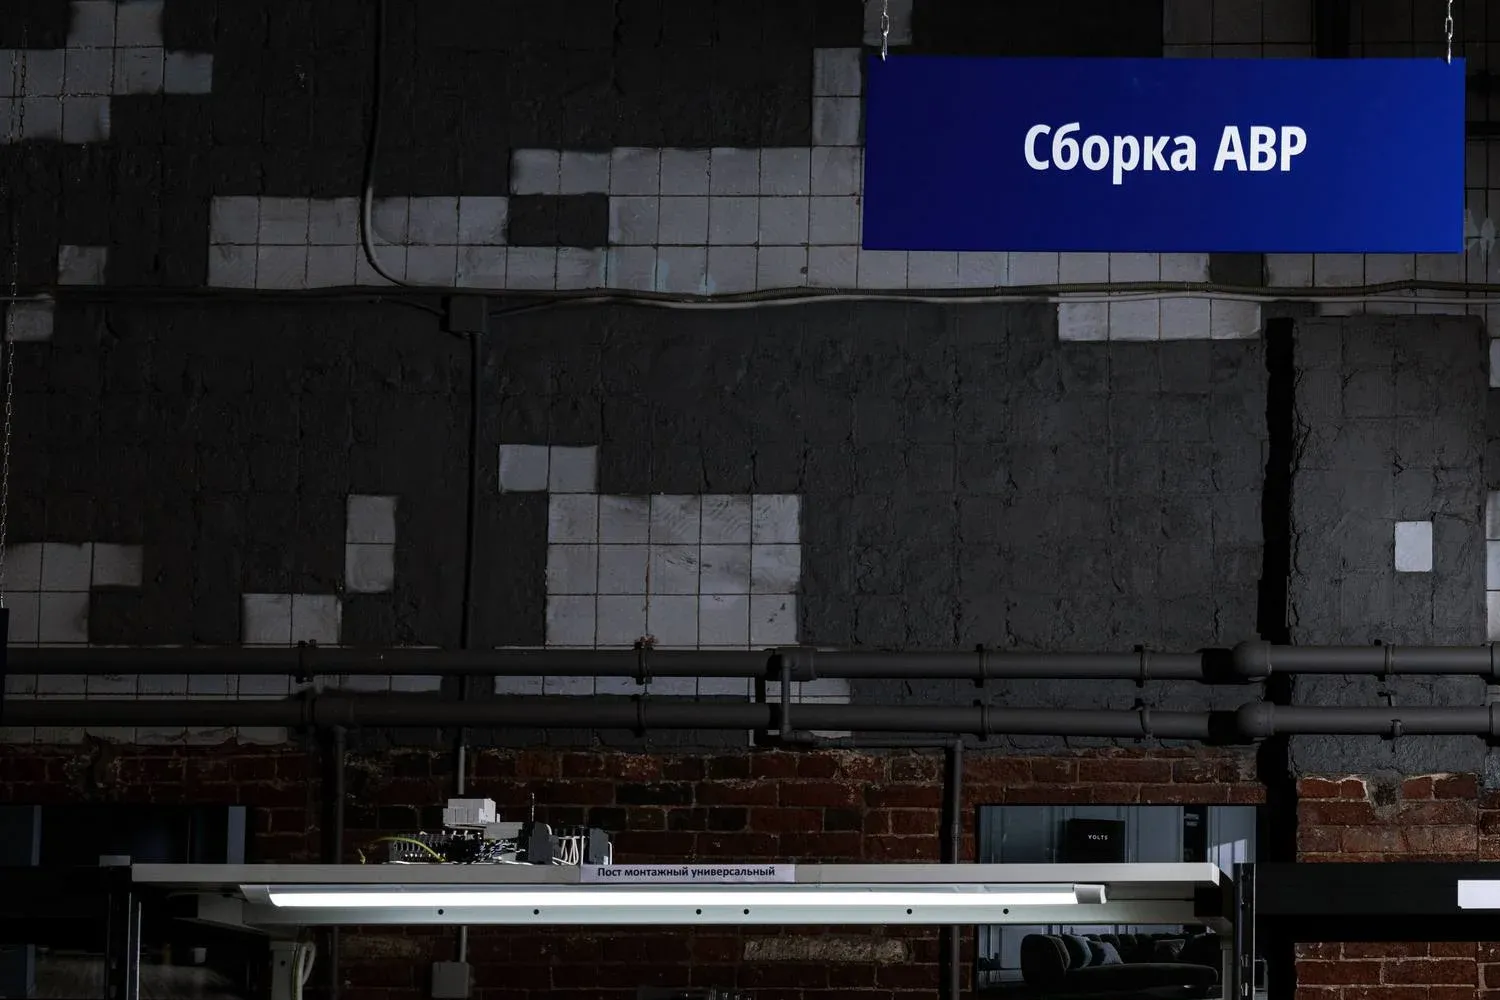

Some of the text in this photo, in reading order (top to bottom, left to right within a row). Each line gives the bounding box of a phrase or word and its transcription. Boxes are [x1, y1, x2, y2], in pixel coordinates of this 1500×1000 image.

[1024, 122, 1308, 185] Сборка АВР
[597, 866, 776, 878] Пост монтажный универсальный
